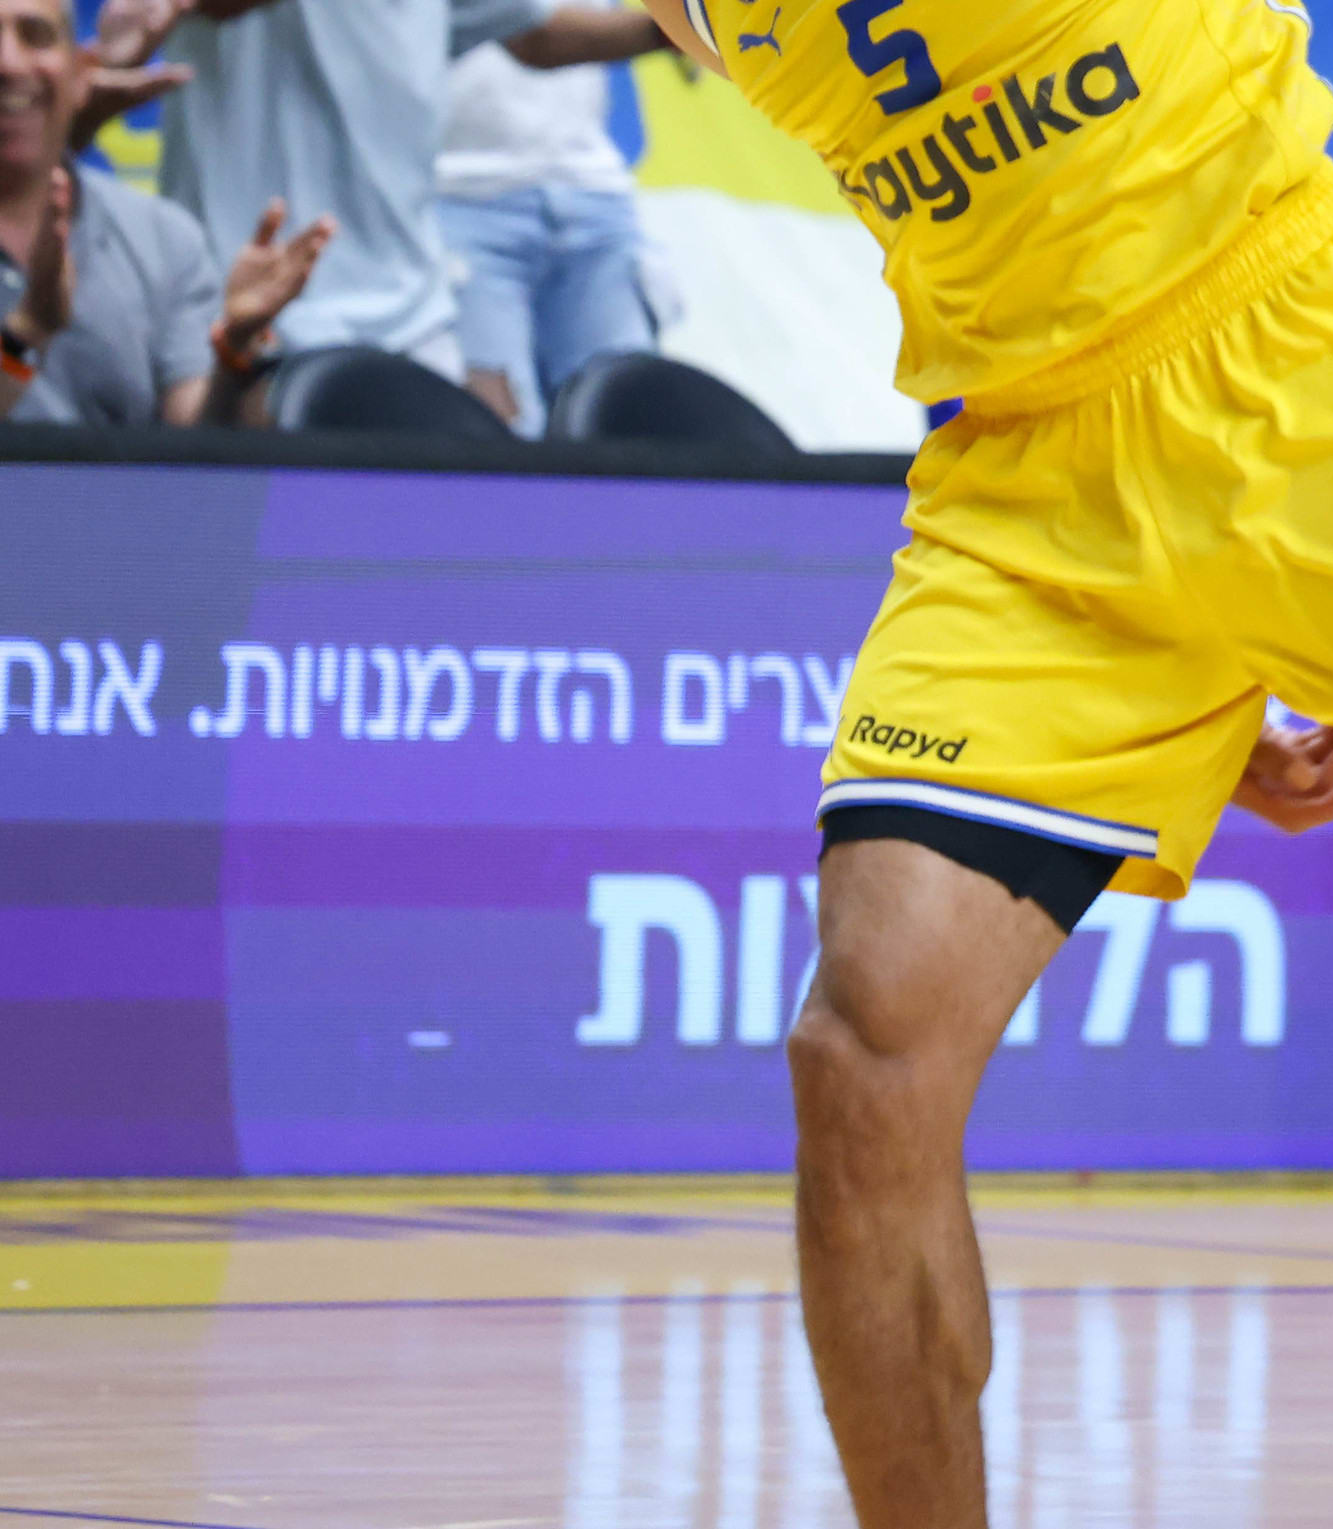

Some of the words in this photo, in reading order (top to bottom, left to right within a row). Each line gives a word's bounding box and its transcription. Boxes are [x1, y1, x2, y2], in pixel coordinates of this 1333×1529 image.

[841, 41, 1140, 222] aytika
[188, 640, 634, 744] הזדמנויות.
[849, 715, 968, 763] Rapyd
